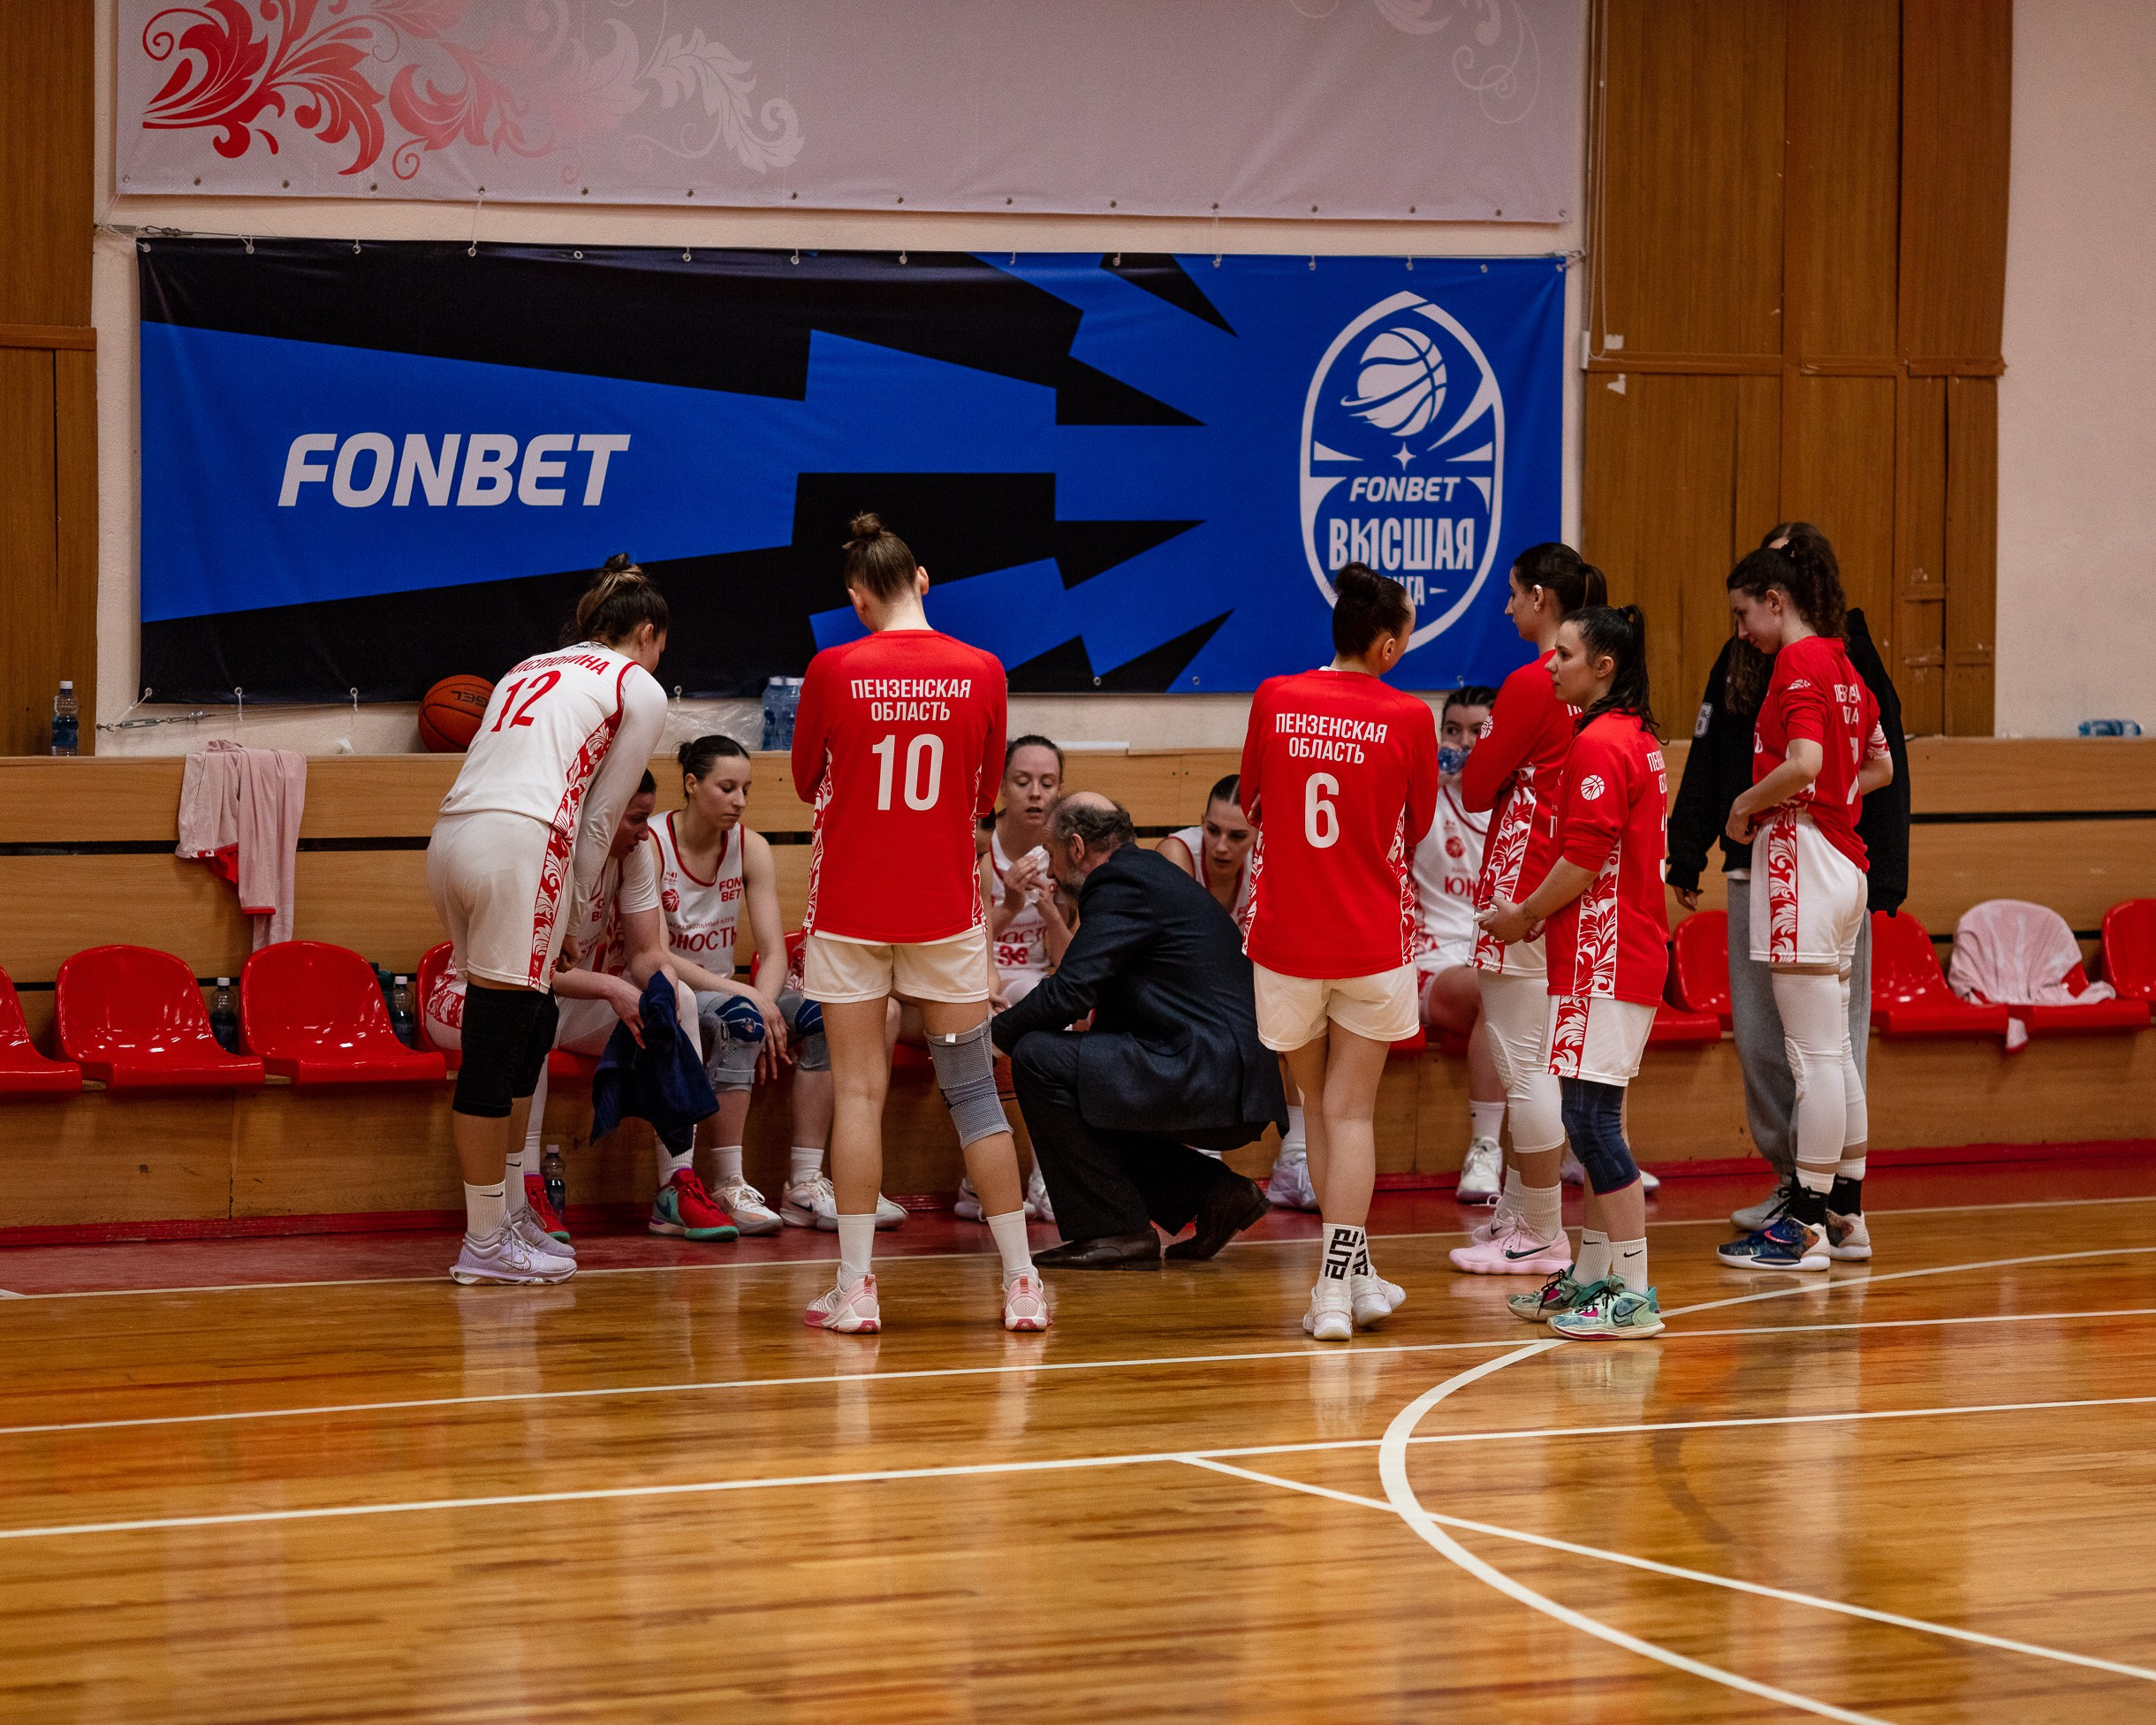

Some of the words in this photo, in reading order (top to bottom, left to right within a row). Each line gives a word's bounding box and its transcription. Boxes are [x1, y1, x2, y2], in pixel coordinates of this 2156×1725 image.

[277, 432, 632, 508] FONBET
[1349, 476, 1461, 502] FONBET
[1329, 518, 1475, 571] ВЫСШАЯ
[1383, 575, 1425, 606] ГА
[490, 670, 561, 733] 12
[850, 679, 972, 699] ПЕНЗЕНСКАЯ
[870, 702, 951, 721] ОБЛАСТЬ
[1275, 713, 1388, 744] ПЕНЗЕНСКАЯ
[1288, 737, 1365, 764] ОБЛАСТЬ
[872, 733, 945, 811] 10
[1304, 771, 1340, 848] 6
[718, 876, 742, 892] FON
[720, 888, 742, 902] BET
[1325, 1228, 1359, 1280] ELITE
